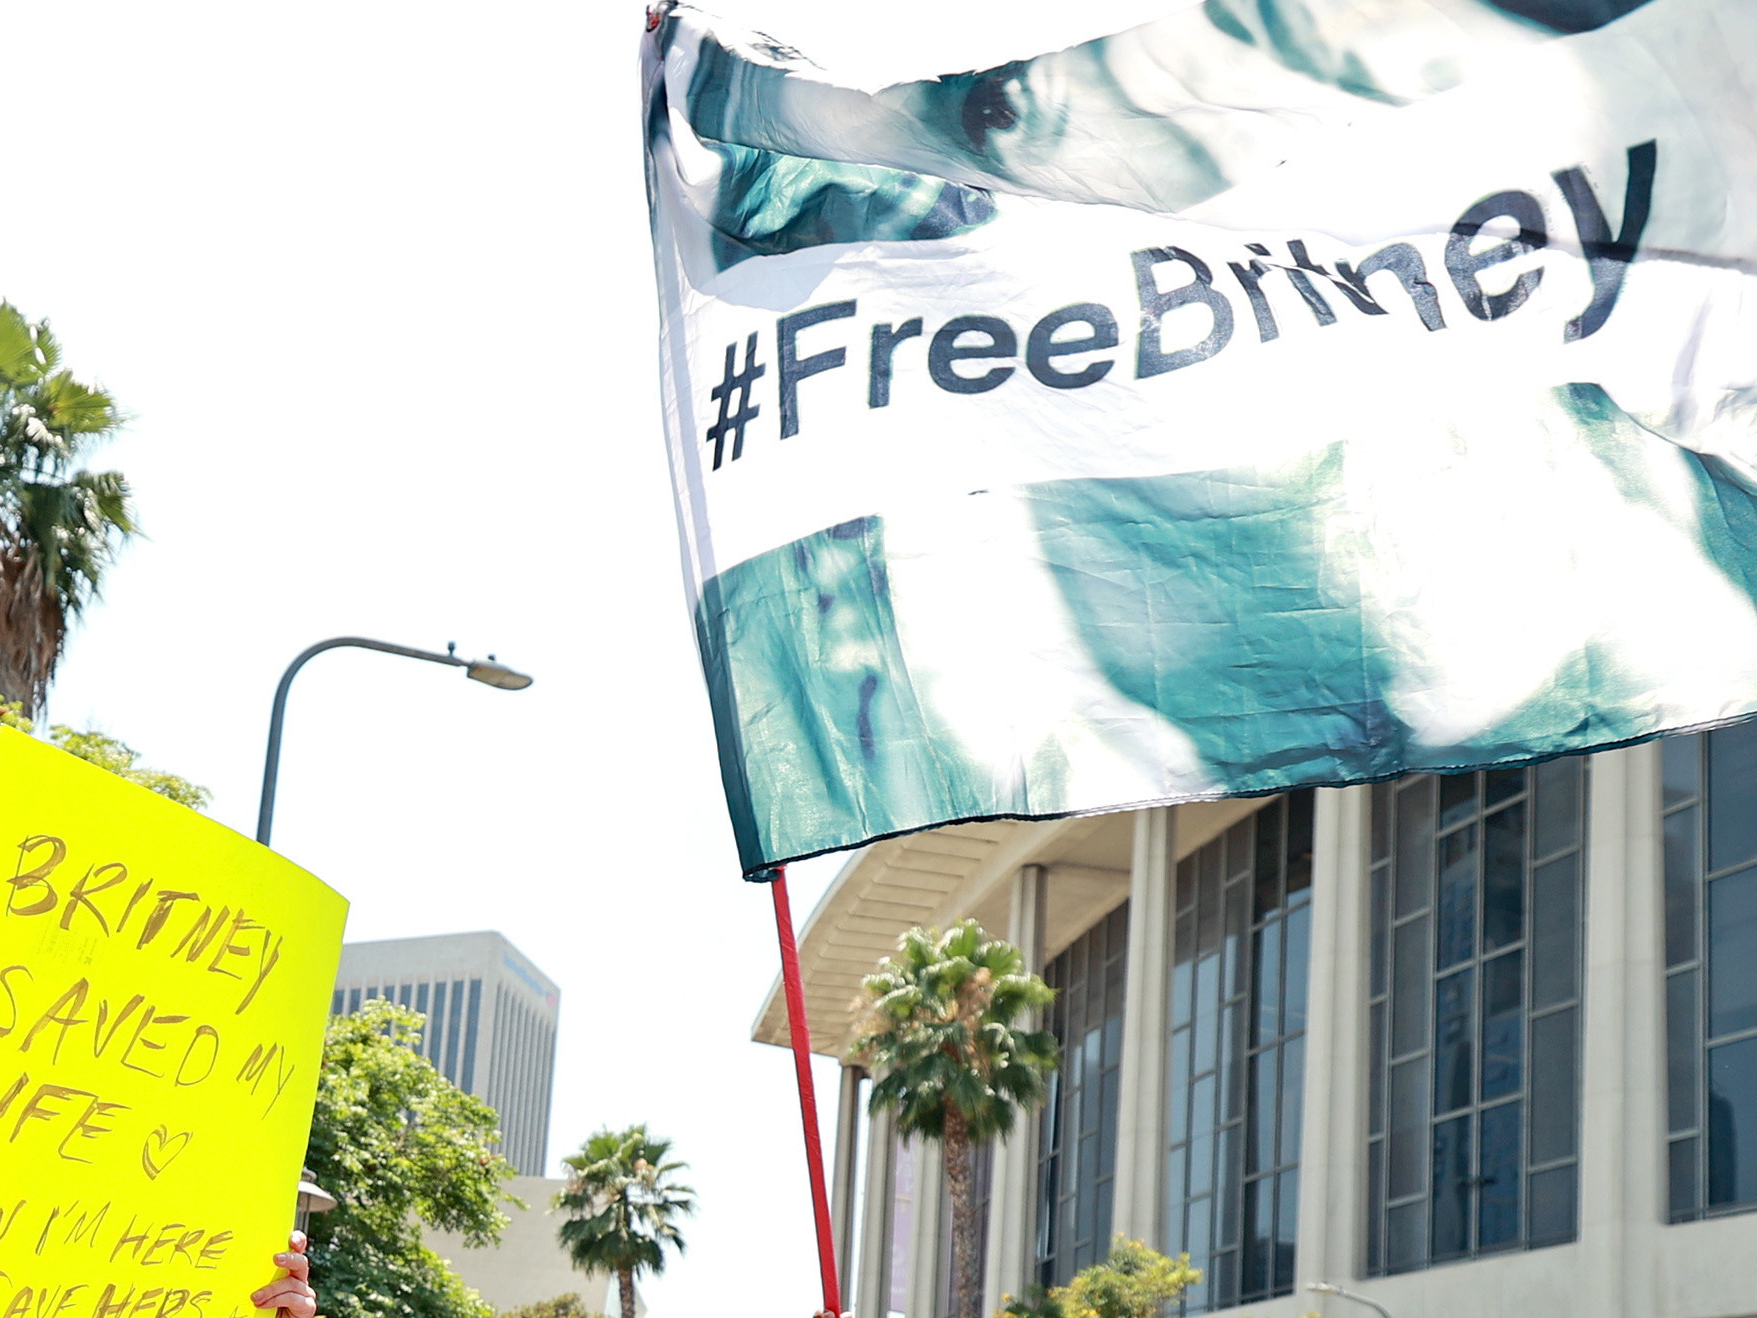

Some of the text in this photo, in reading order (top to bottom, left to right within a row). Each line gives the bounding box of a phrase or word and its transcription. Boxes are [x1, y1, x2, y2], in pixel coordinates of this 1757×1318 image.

[707, 137, 1657, 471] #FreeBritney
[6, 835, 283, 1015] BRITNEY
[236, 1041, 295, 1120] MY
[35, 1200, 111, 1255] I'M
[110, 1214, 234, 1269] HERE
